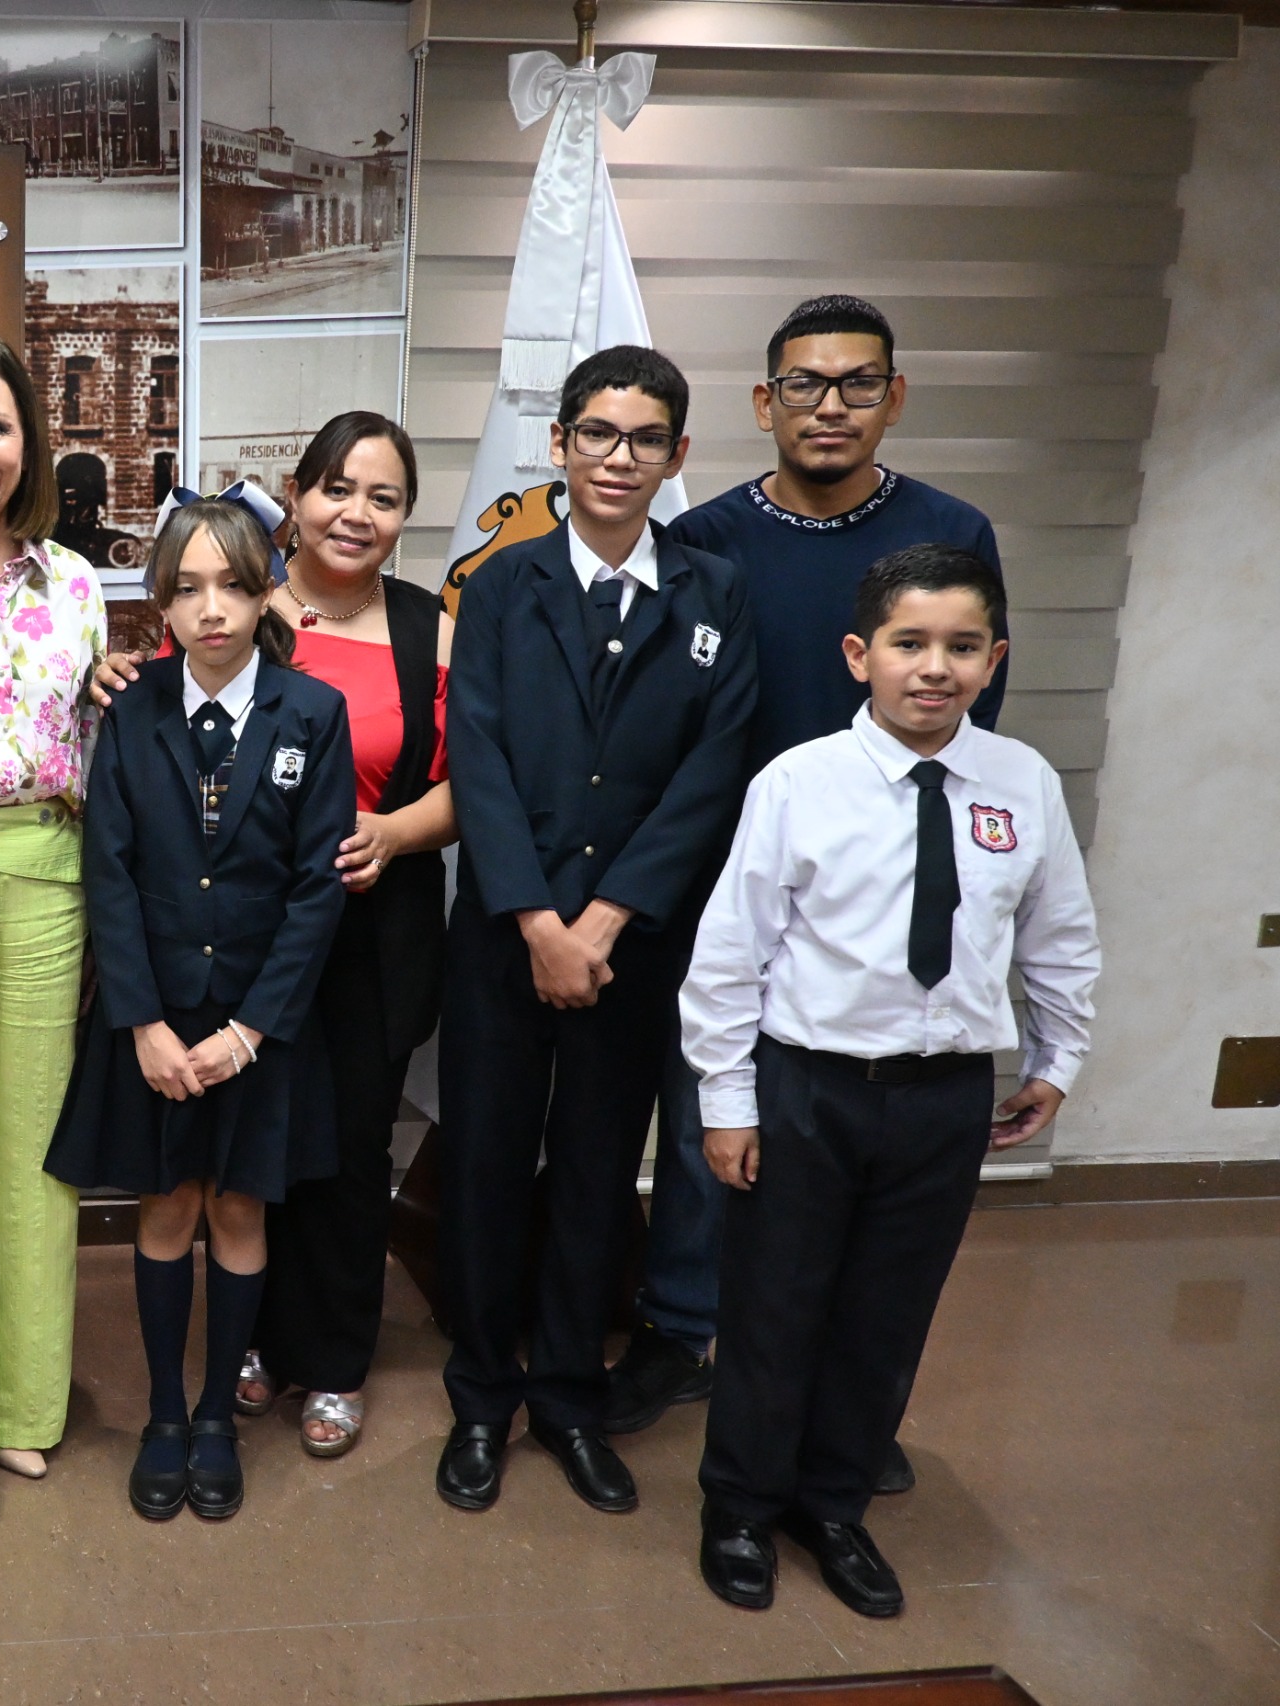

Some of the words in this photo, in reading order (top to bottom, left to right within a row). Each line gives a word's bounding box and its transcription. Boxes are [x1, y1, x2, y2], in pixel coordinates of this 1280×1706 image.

[239, 444, 299, 458] PRESIDENCIA
[762, 504, 844, 530] EXPLODE
[848, 471, 898, 523] EXPLODE
